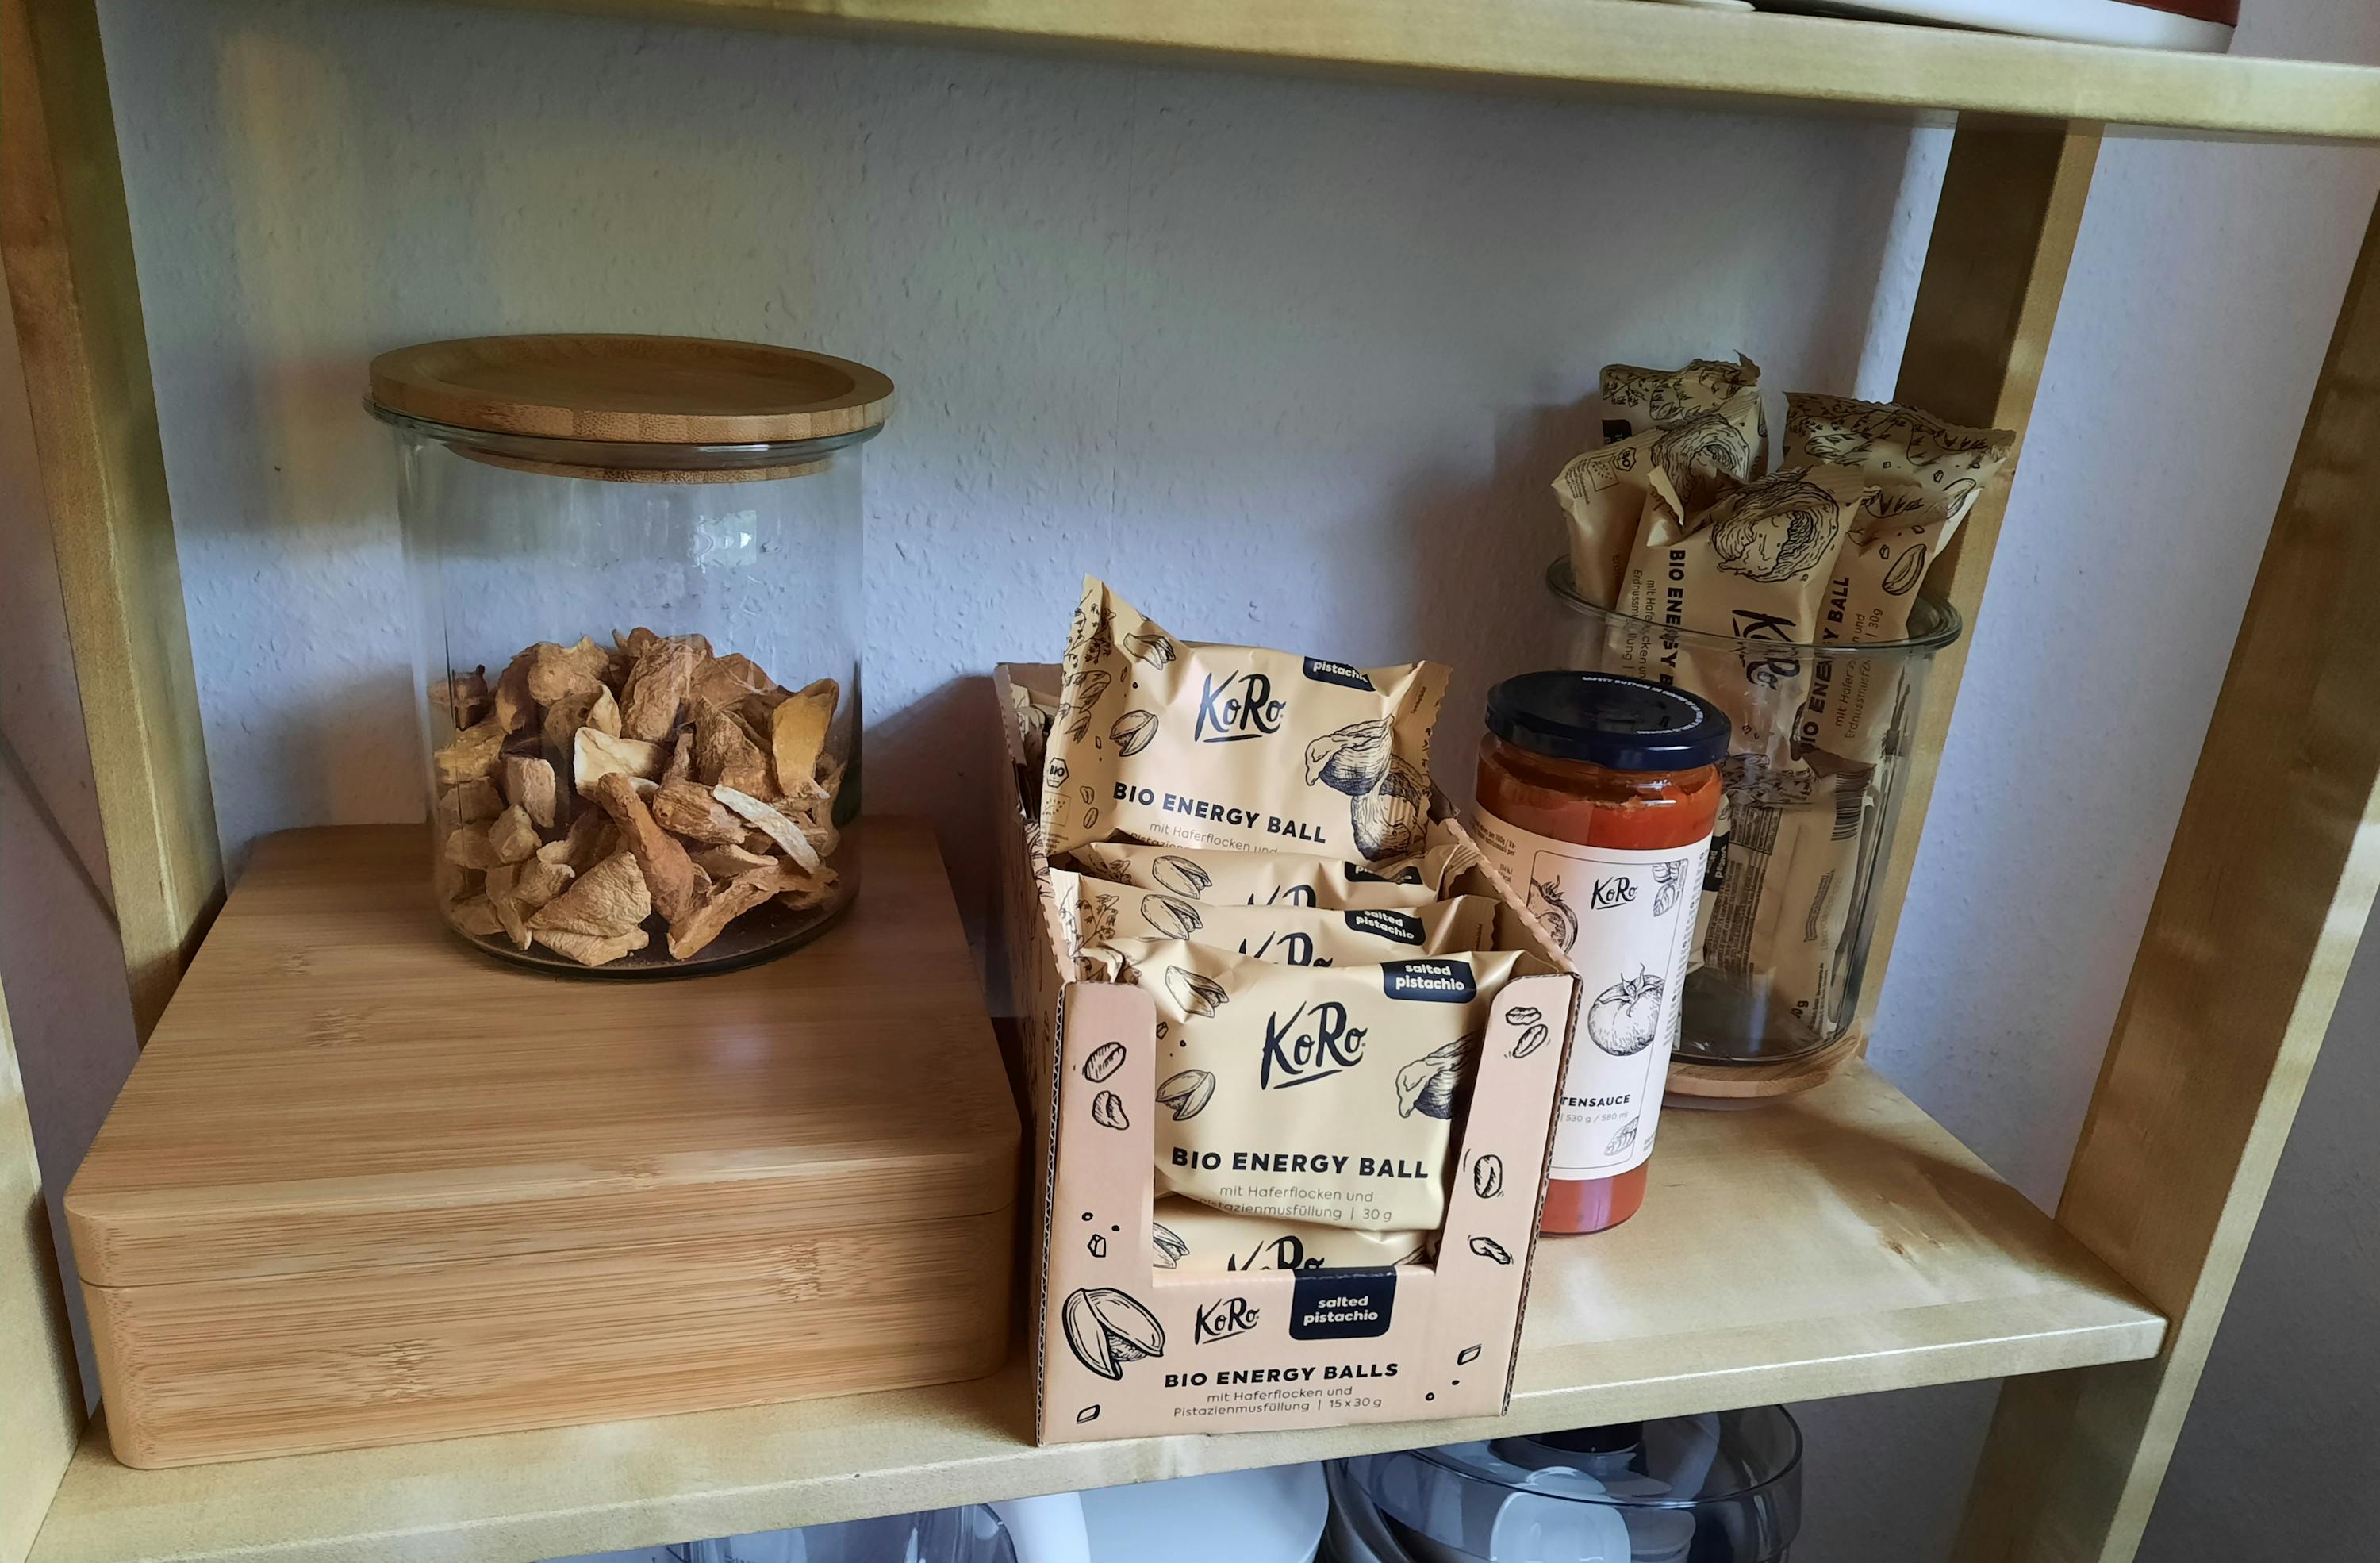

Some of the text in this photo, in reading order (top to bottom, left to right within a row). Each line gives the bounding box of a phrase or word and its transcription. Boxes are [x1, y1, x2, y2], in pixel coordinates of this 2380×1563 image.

[1669, 550, 1686, 582] BIO
[1646, 579, 1655, 595] mit
[1827, 577, 1849, 624] BALL
[1834, 705, 1847, 727] mit
[1853, 613, 1865, 633] und
[1194, 670, 1286, 743] KoRo
[1050, 765, 1065, 777] BIO
[1113, 782, 1326, 844] BIO ENERGY BALL
[1150, 822, 1170, 834] mit
[1173, 826, 1251, 852] Haferflocken
[1591, 876, 1637, 910] KoRo
[1355, 915, 1415, 939] pistachio
[1363, 910, 1403, 928] salted
[1405, 963, 1452, 977] salted
[1395, 974, 1465, 991] pistachio
[1261, 1001, 1368, 1091] KoRo
[1560, 1094, 1631, 1108] TENSAUCE
[1566, 1114, 1583, 1123] 530
[1602, 1112, 1617, 1121] 580
[1172, 1147, 1429, 1179] BIO ENERGY BALL
[1219, 1185, 1374, 1202] mit Haferflocken und
[1318, 1296, 1369, 1308] salted
[1194, 1296, 1260, 1345] KoRo
[1303, 1310, 1379, 1326] pistachio
[1165, 1362, 1399, 1388] BIO ENERGY BALLS
[1207, 1386, 1353, 1403] mit Haferflocken und
[1173, 1400, 1310, 1418] Pistazienmusfüllung
